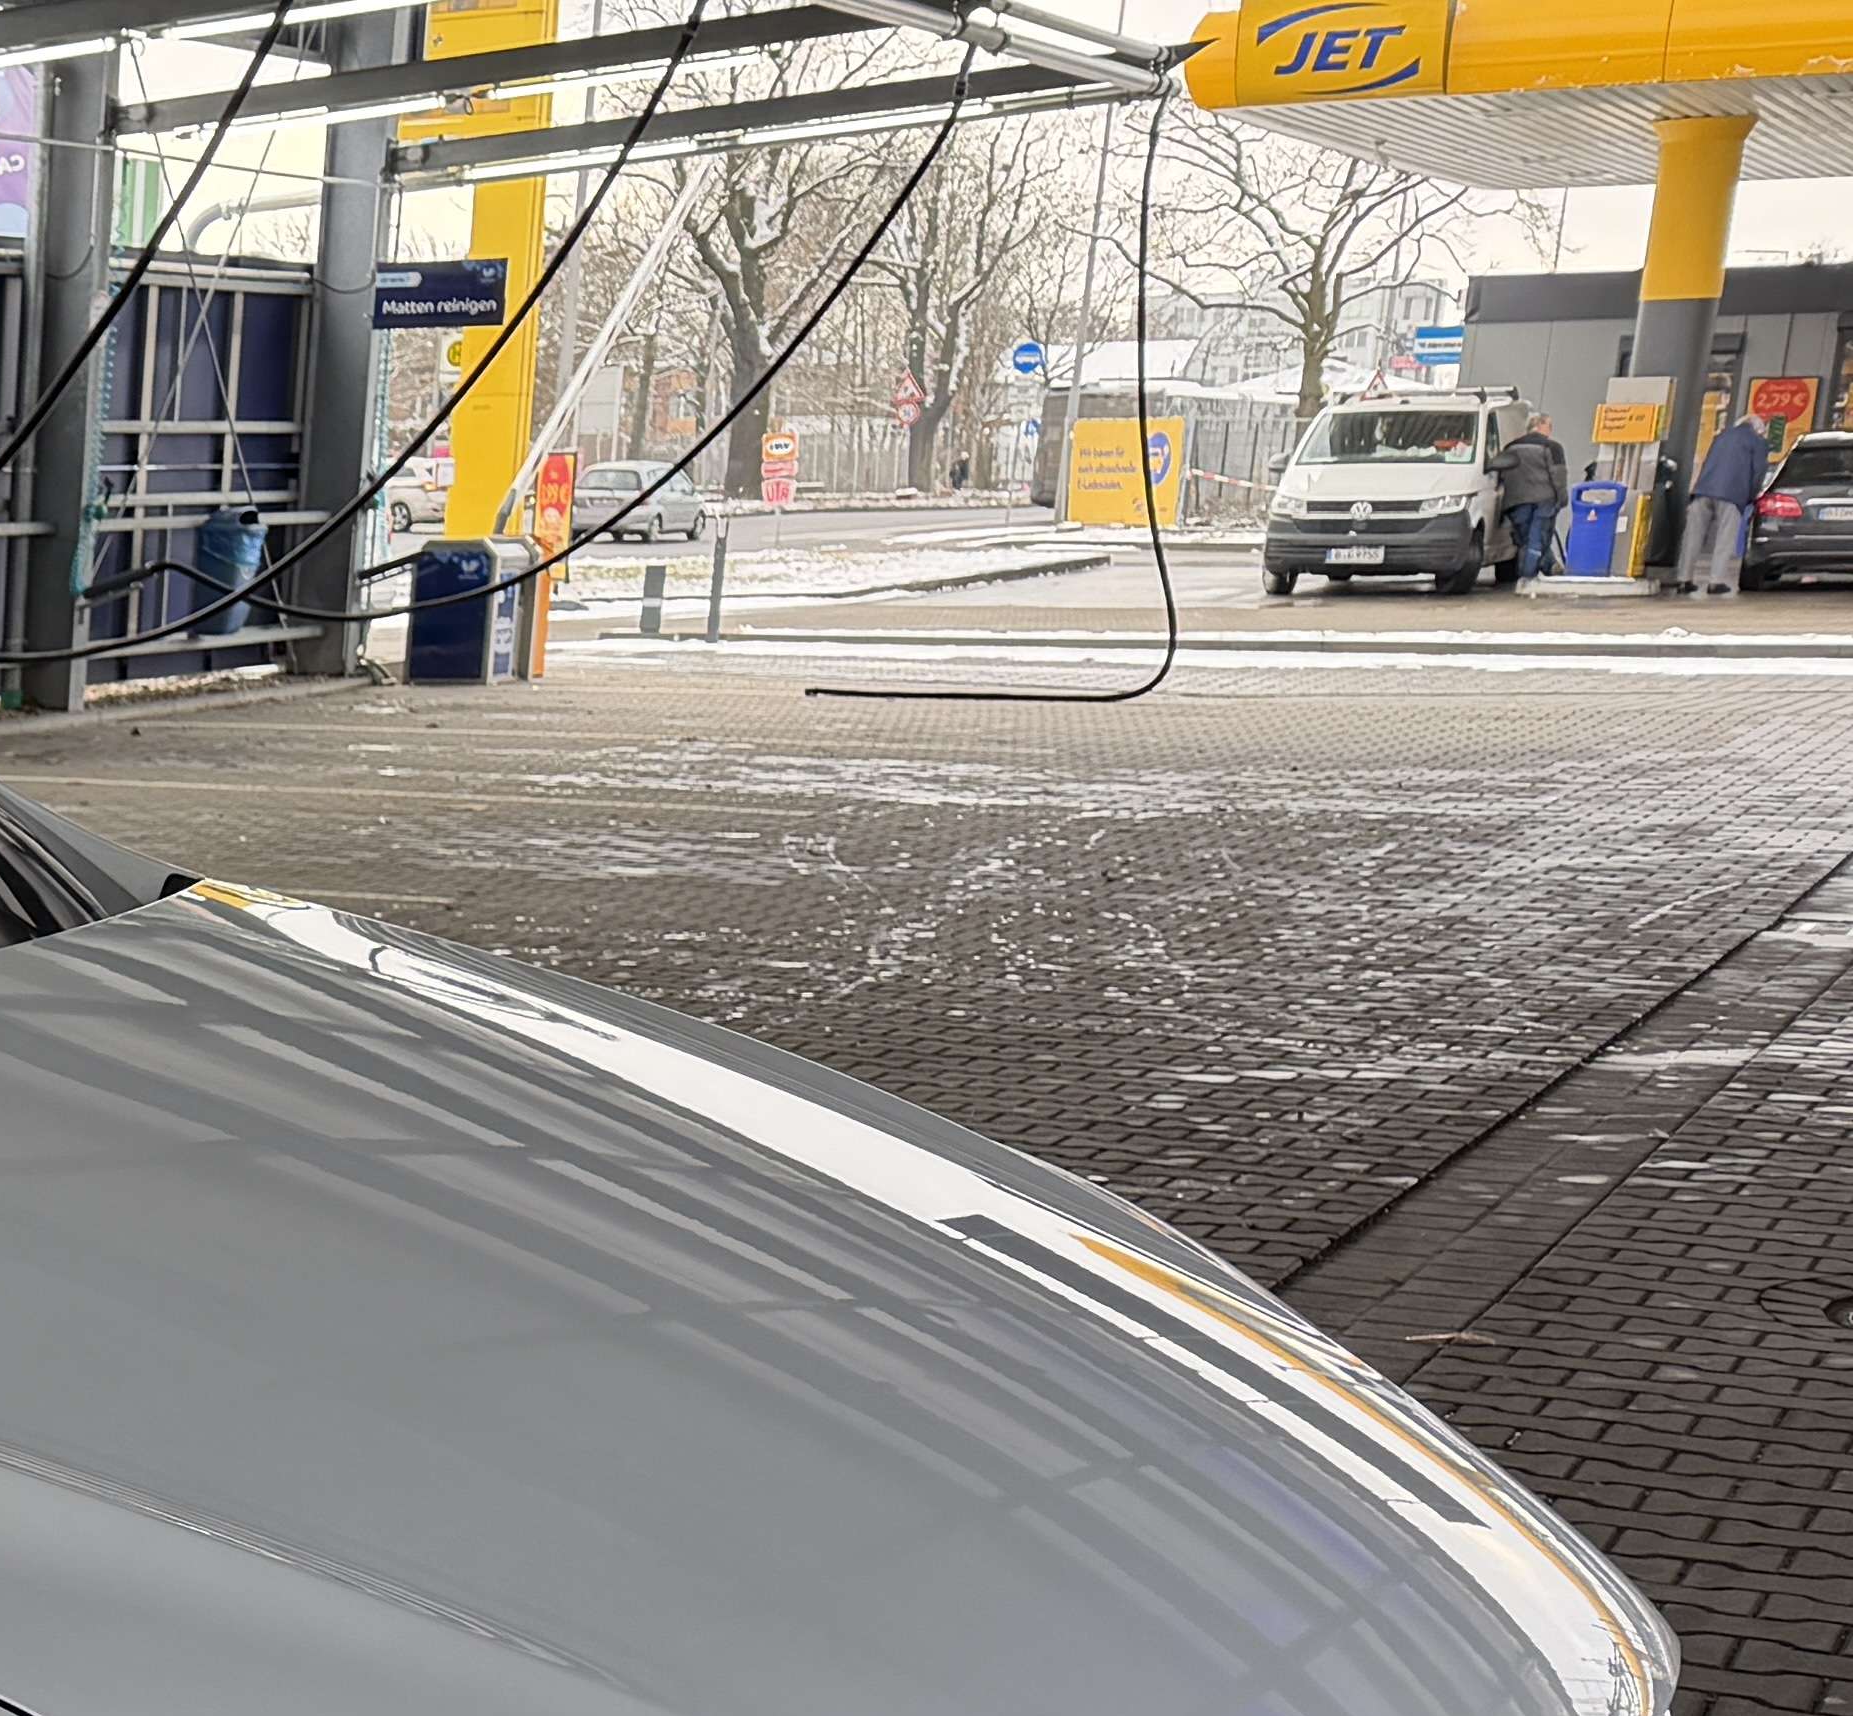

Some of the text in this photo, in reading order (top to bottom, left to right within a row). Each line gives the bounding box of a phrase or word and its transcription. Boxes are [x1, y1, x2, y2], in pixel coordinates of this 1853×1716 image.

[1274, 25, 1406, 75] JET
[381, 296, 497, 316] Matten reinigen
